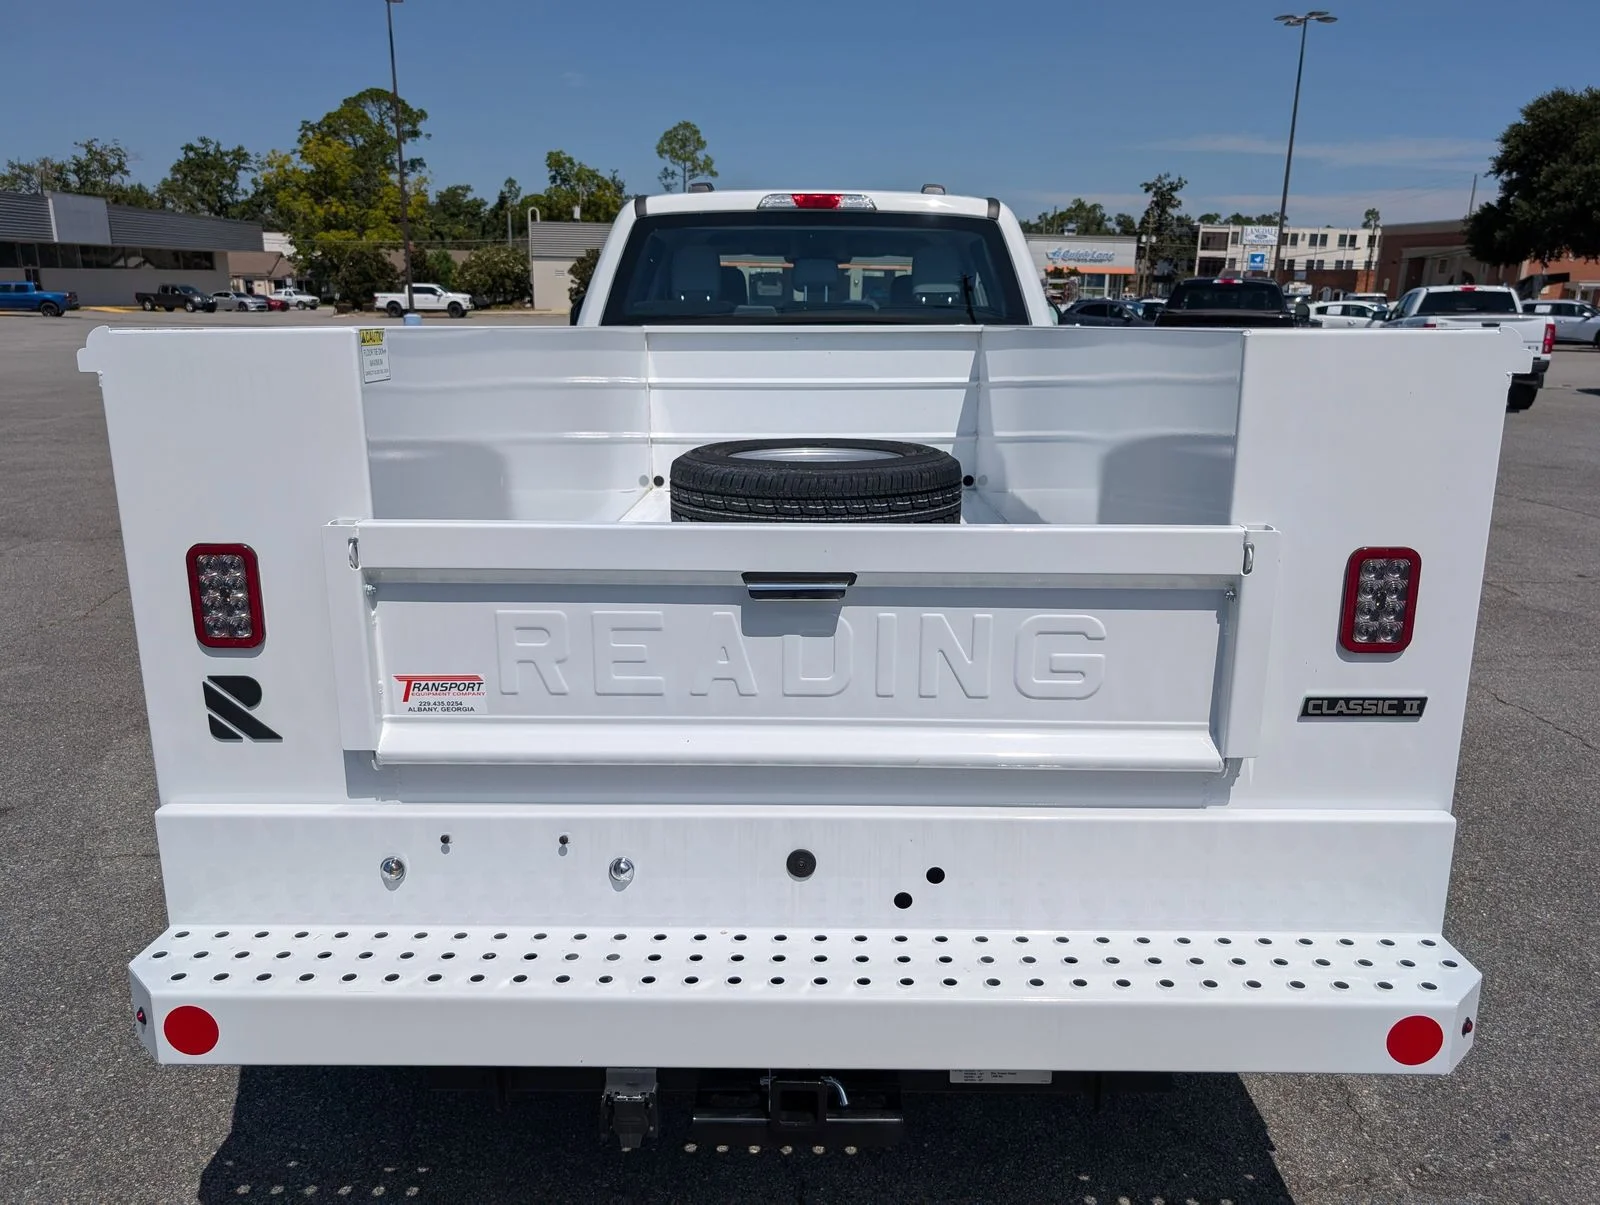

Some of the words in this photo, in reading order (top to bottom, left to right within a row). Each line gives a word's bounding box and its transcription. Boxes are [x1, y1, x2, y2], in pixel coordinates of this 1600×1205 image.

[494, 608, 1108, 701] READING
[1308, 700, 1398, 714] CLASSIC
[1402, 700, 1421, 714] II
